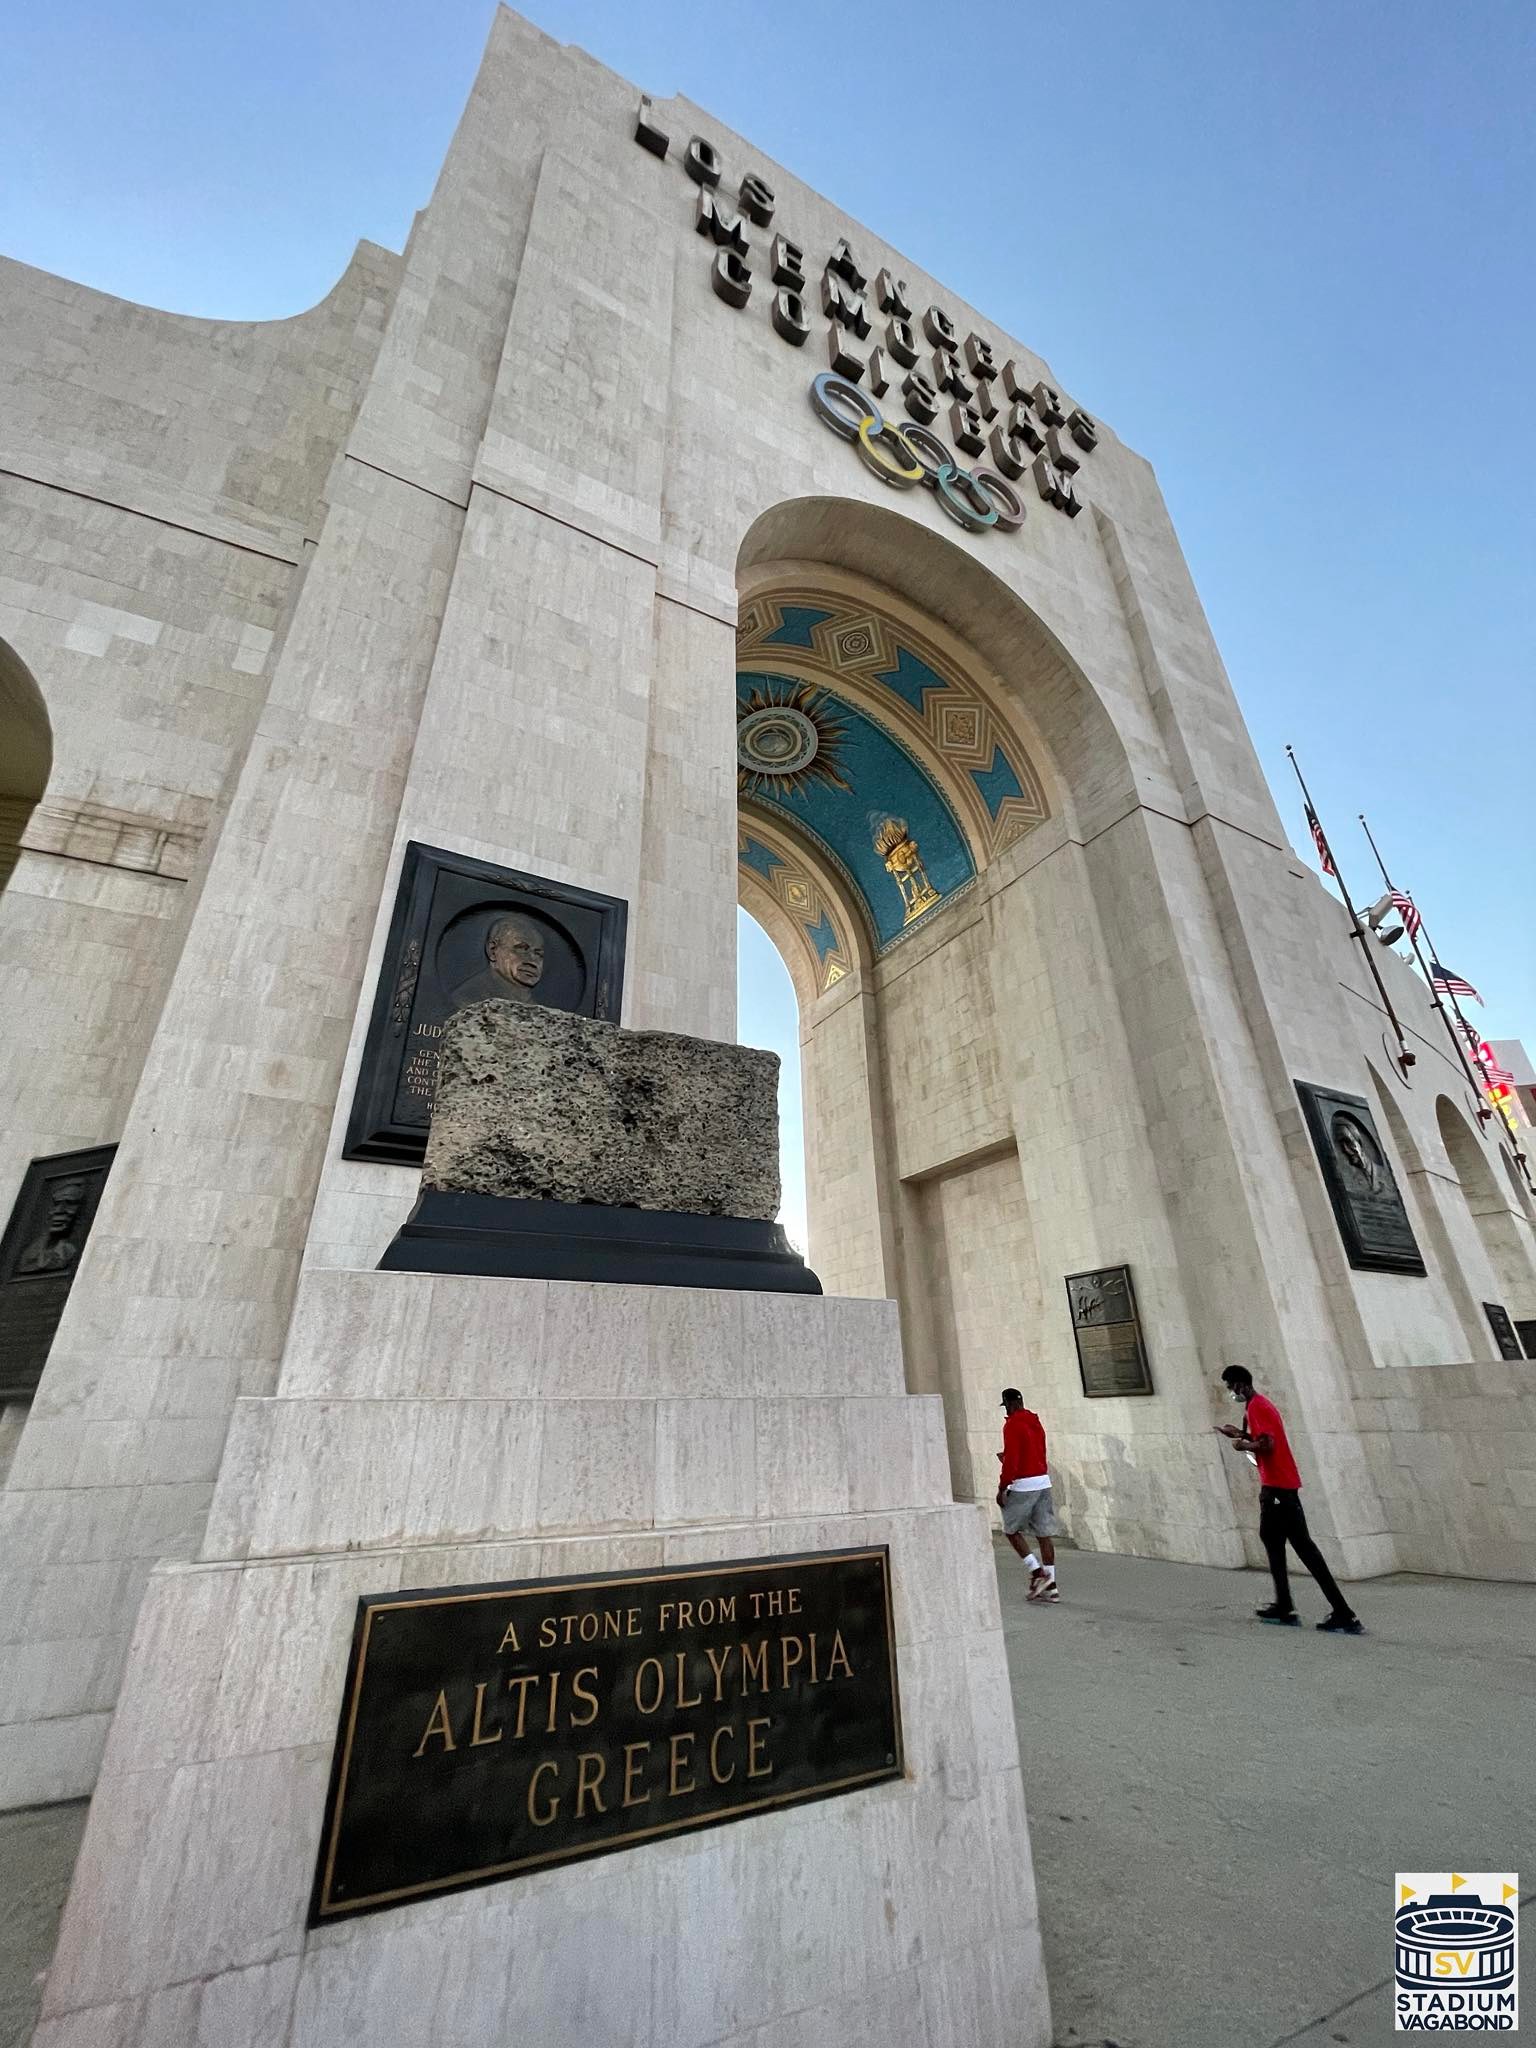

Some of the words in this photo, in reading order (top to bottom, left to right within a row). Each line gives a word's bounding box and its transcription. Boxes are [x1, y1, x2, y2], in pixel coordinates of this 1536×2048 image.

[634, 95, 775, 229] LOS
[824, 237, 1098, 453] ANGELES
[696, 184, 1081, 475] MEMORIAL
[711, 247, 1083, 519] COLISEUM
[413, 1666, 602, 1759] ALTIS
[634, 1628, 855, 1716] OLYMPIA
[496, 1621, 522, 1654] A
[538, 1607, 643, 1649] STONE
[658, 1595, 737, 1633] FROM
[749, 1588, 804, 1618] THE
[527, 1717, 775, 1828] GREECE
